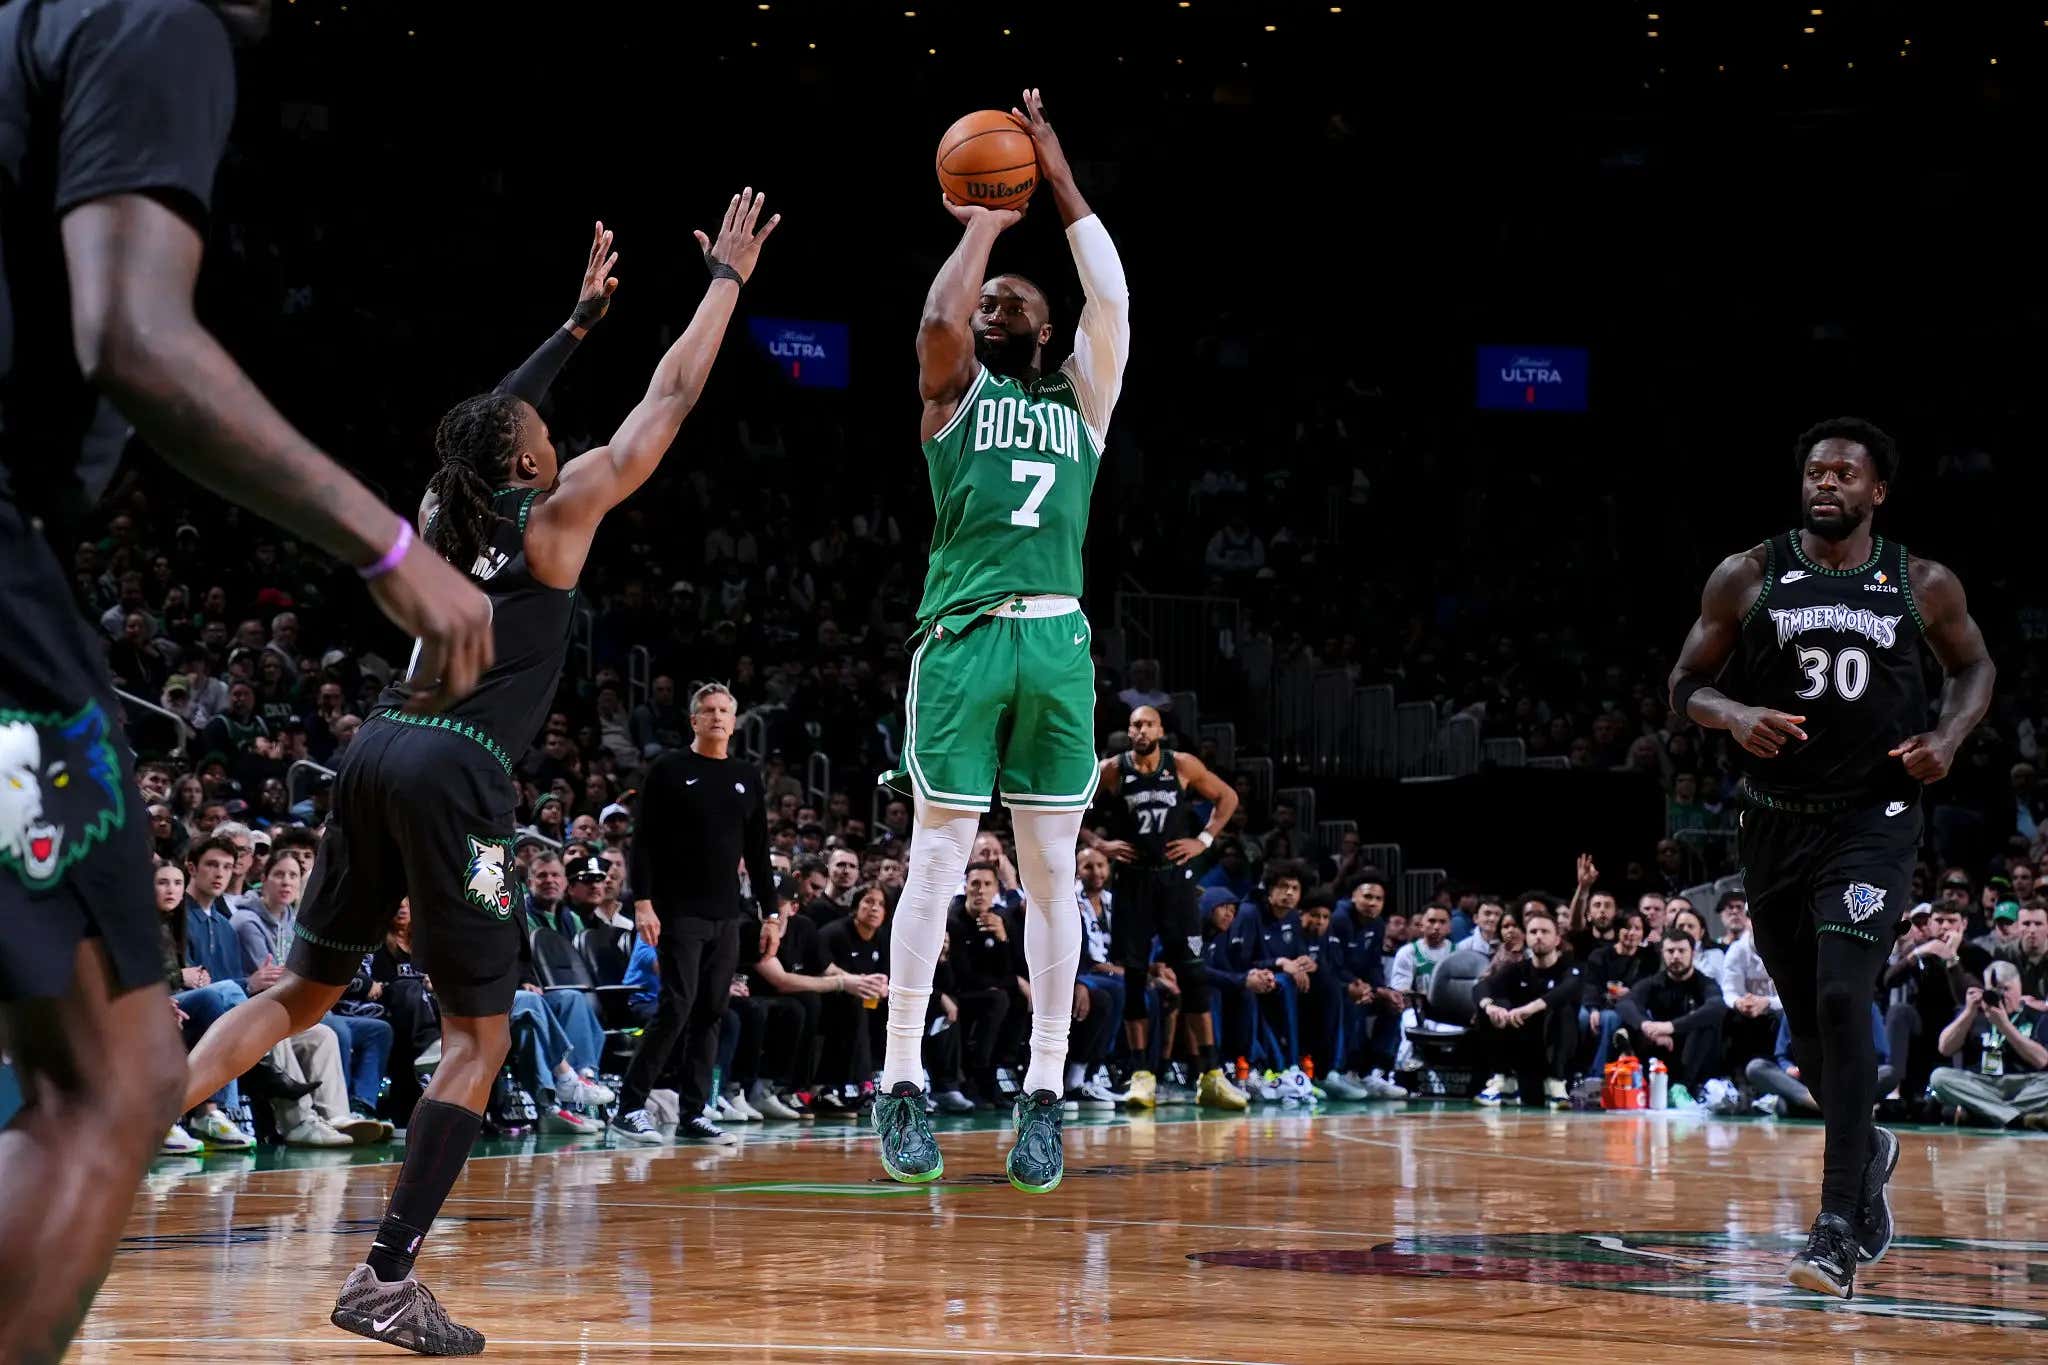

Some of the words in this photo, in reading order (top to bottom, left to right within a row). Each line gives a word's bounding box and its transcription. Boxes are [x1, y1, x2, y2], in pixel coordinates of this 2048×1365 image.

[967, 178, 1034, 199] Wilson
[769, 341, 826, 359] ULTRA
[1501, 367, 1563, 384] ULTRA
[1038, 382, 1069, 394] Amica
[975, 397, 1079, 463] BOSTON
[1011, 459, 1056, 528] 7
[1863, 583, 1899, 594] sezzle
[1768, 603, 1904, 650] TIMBERWOLVES
[1795, 644, 1870, 701] 30
[1138, 808, 1168, 834] 27
